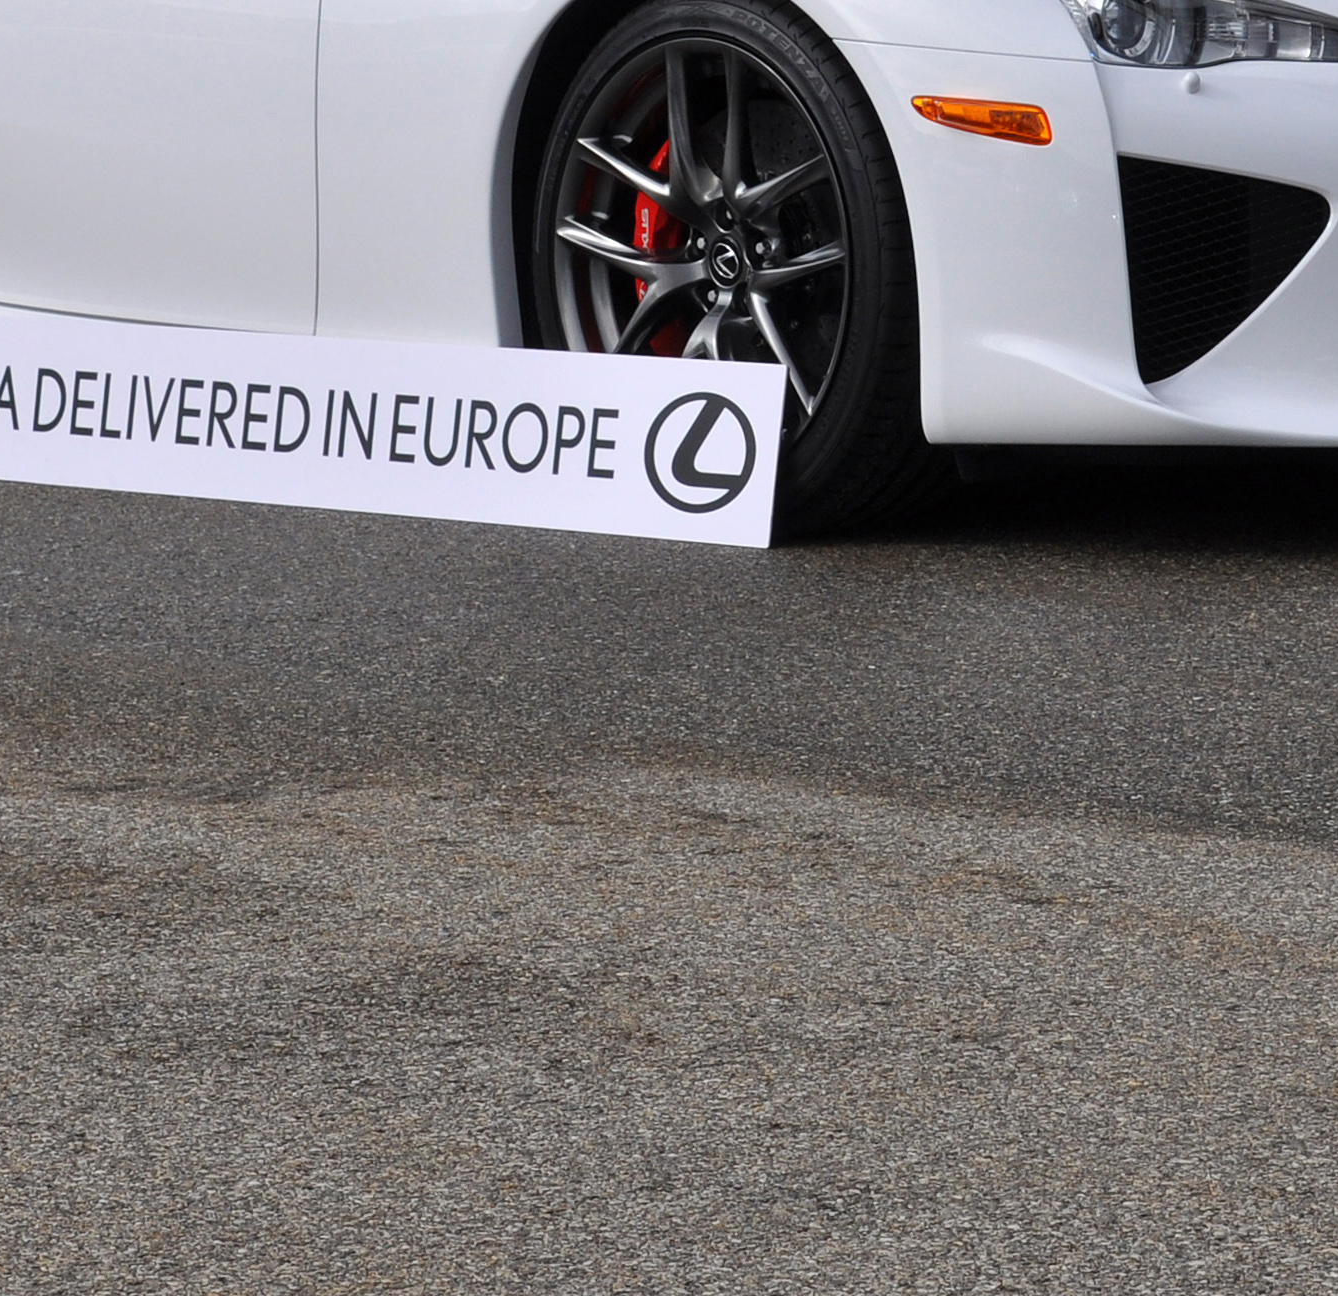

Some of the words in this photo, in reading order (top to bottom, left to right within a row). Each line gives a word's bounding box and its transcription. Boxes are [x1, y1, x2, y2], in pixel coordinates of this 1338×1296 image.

[32, 368, 310, 453] DELIVERED
[322, 389, 377, 460] IN
[388, 395, 619, 479] EUROPE
